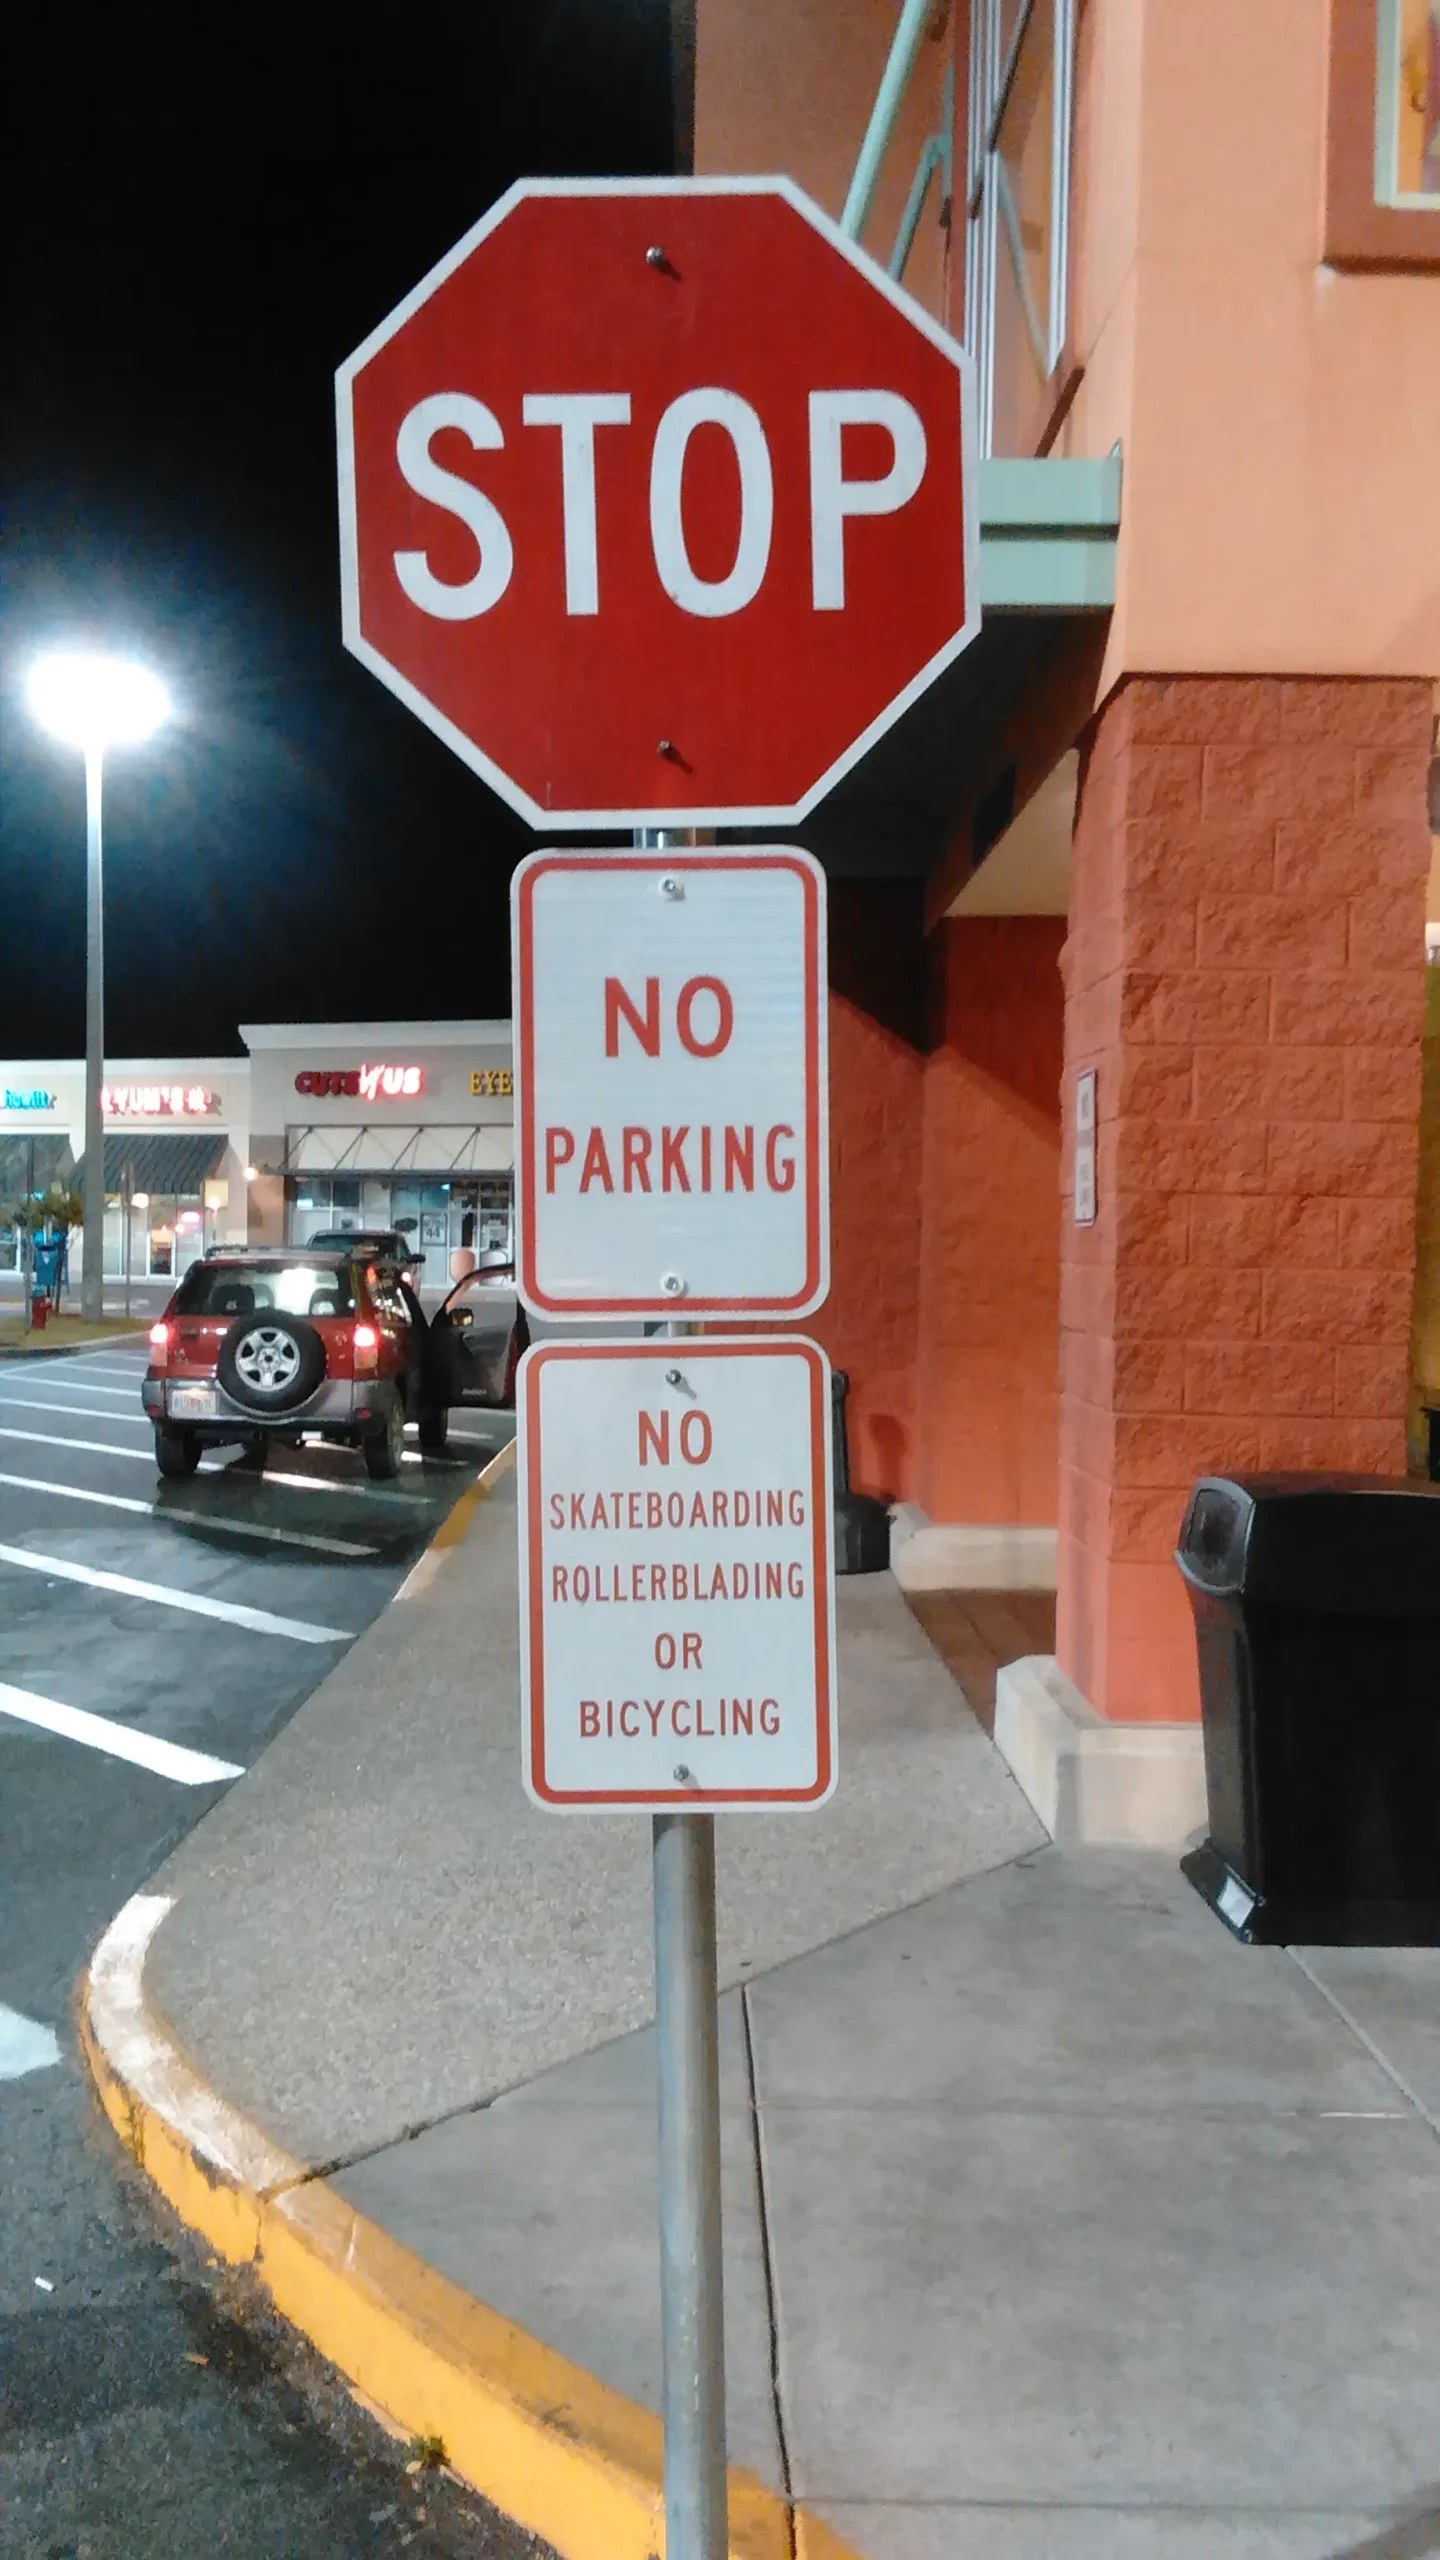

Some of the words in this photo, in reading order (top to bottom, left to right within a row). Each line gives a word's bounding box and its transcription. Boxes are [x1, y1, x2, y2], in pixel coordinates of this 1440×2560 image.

[394, 387, 926, 620] STOP
[604, 975, 733, 1059] NO
[545, 1124, 796, 1194] PARKING
[638, 1410, 712, 1465] NO
[550, 1490, 805, 1530] SKATEBOARDING
[553, 1562, 804, 1602] ROLLERBLADING
[655, 1632, 703, 1670] OR
[580, 1699, 781, 1737] BICYCLING
